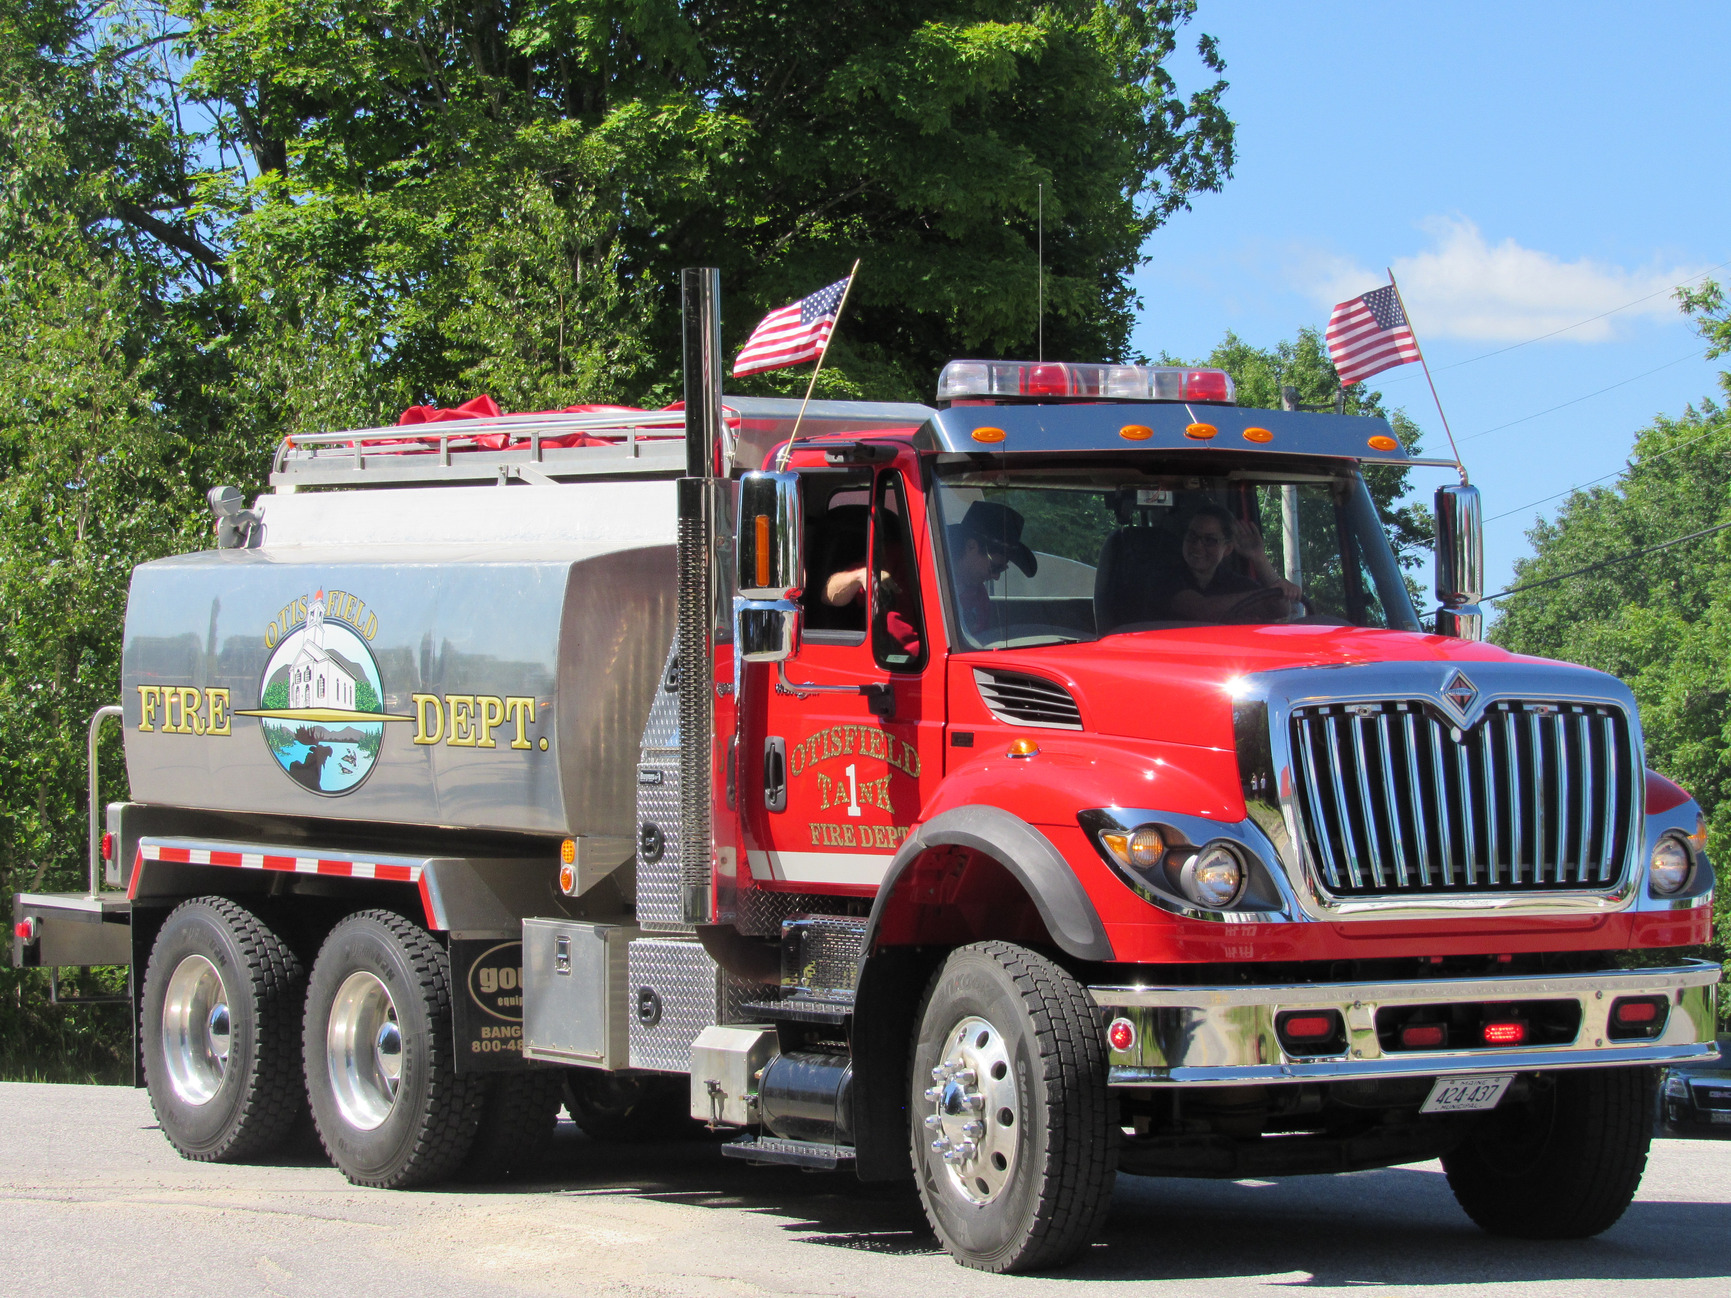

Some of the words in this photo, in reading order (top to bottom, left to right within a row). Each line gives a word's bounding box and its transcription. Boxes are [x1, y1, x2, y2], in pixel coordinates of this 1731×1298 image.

[137, 685, 232, 736] FIRE
[412, 693, 549, 752] DEPT.
[791, 724, 921, 778] OTISFIELD
[809, 822, 857, 847] FIRE
[481, 1025, 523, 1039] BANG
[1435, 1084, 1500, 1104] 424-437
